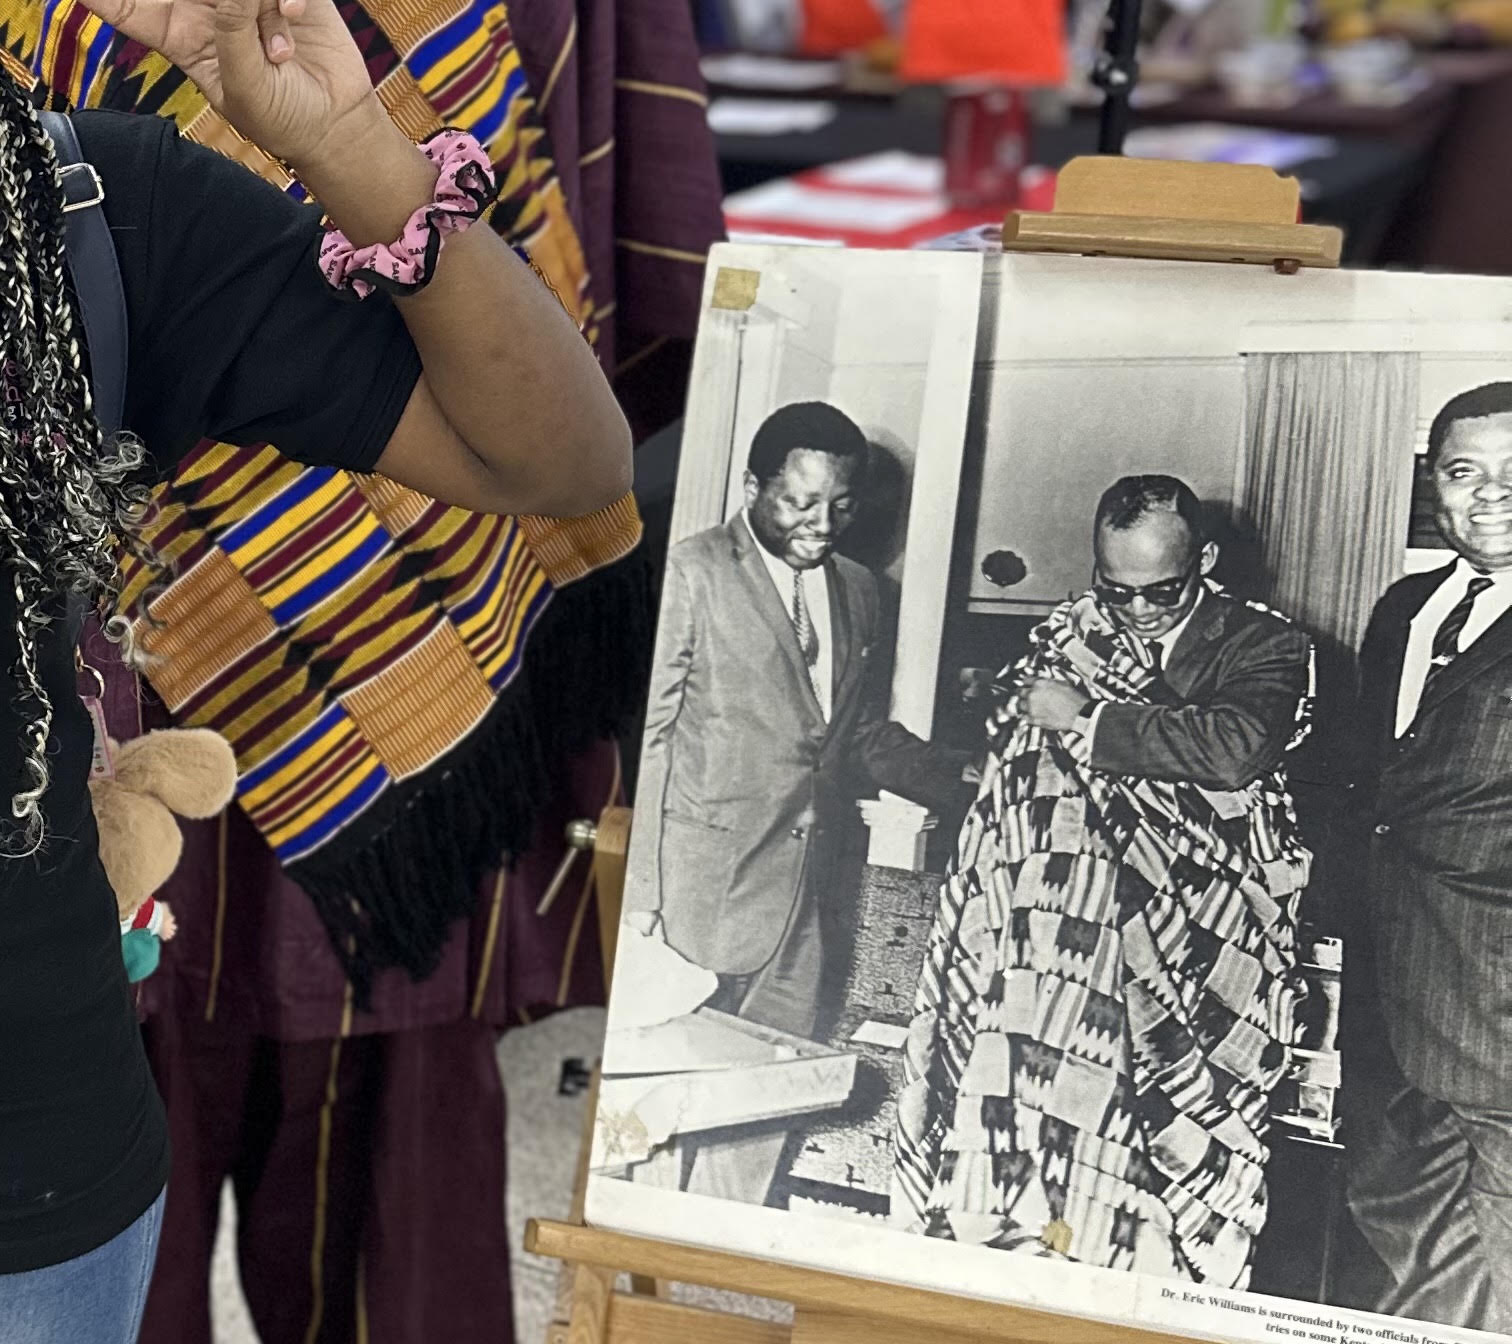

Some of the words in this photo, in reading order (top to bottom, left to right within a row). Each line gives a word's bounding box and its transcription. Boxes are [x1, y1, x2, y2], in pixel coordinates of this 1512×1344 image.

[1161, 1288, 1180, 1300] Dr.
[1183, 1292, 1205, 1304] Eric
[1209, 1297, 1256, 1314] Williams
[1259, 1306, 1268, 1316] is
[1269, 1311, 1333, 1330] surrounded
[1336, 1321, 1349, 1333] by
[1353, 1325, 1373, 1335] two
[1266, 1323, 1290, 1334] tries
[1309, 1333, 1337, 1343] some
